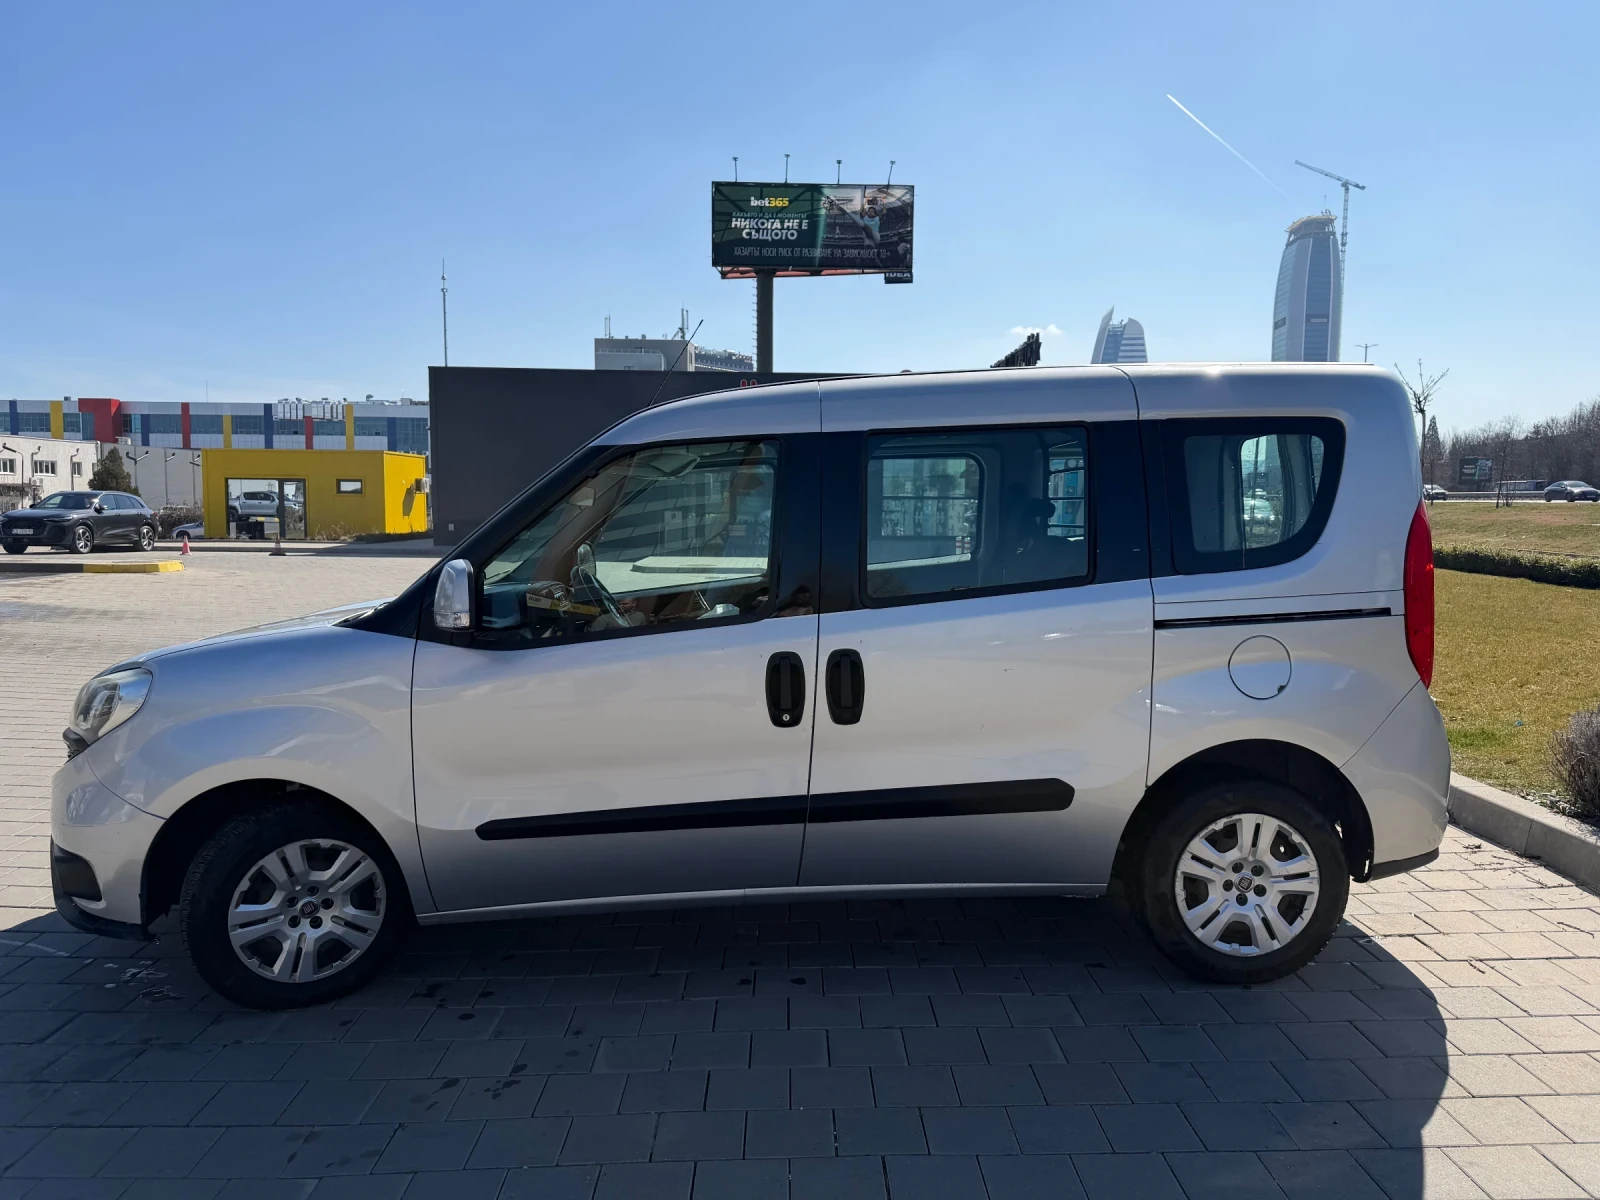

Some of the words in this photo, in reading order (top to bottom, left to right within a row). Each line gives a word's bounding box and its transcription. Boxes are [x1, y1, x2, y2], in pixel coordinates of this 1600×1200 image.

[750, 196, 790, 207] bet365
[731, 218, 782, 230] НИКОГА
[784, 219, 800, 230] НЕ
[801, 219, 809, 230] Е
[742, 229, 798, 242] СЪЩОТО
[733, 246, 761, 256] ХАЗАРТЪТ
[761, 247, 777, 256] НОСИ
[778, 247, 792, 257] РИСК
[794, 248, 801, 257] ОТ
[833, 248, 842, 258] НА
